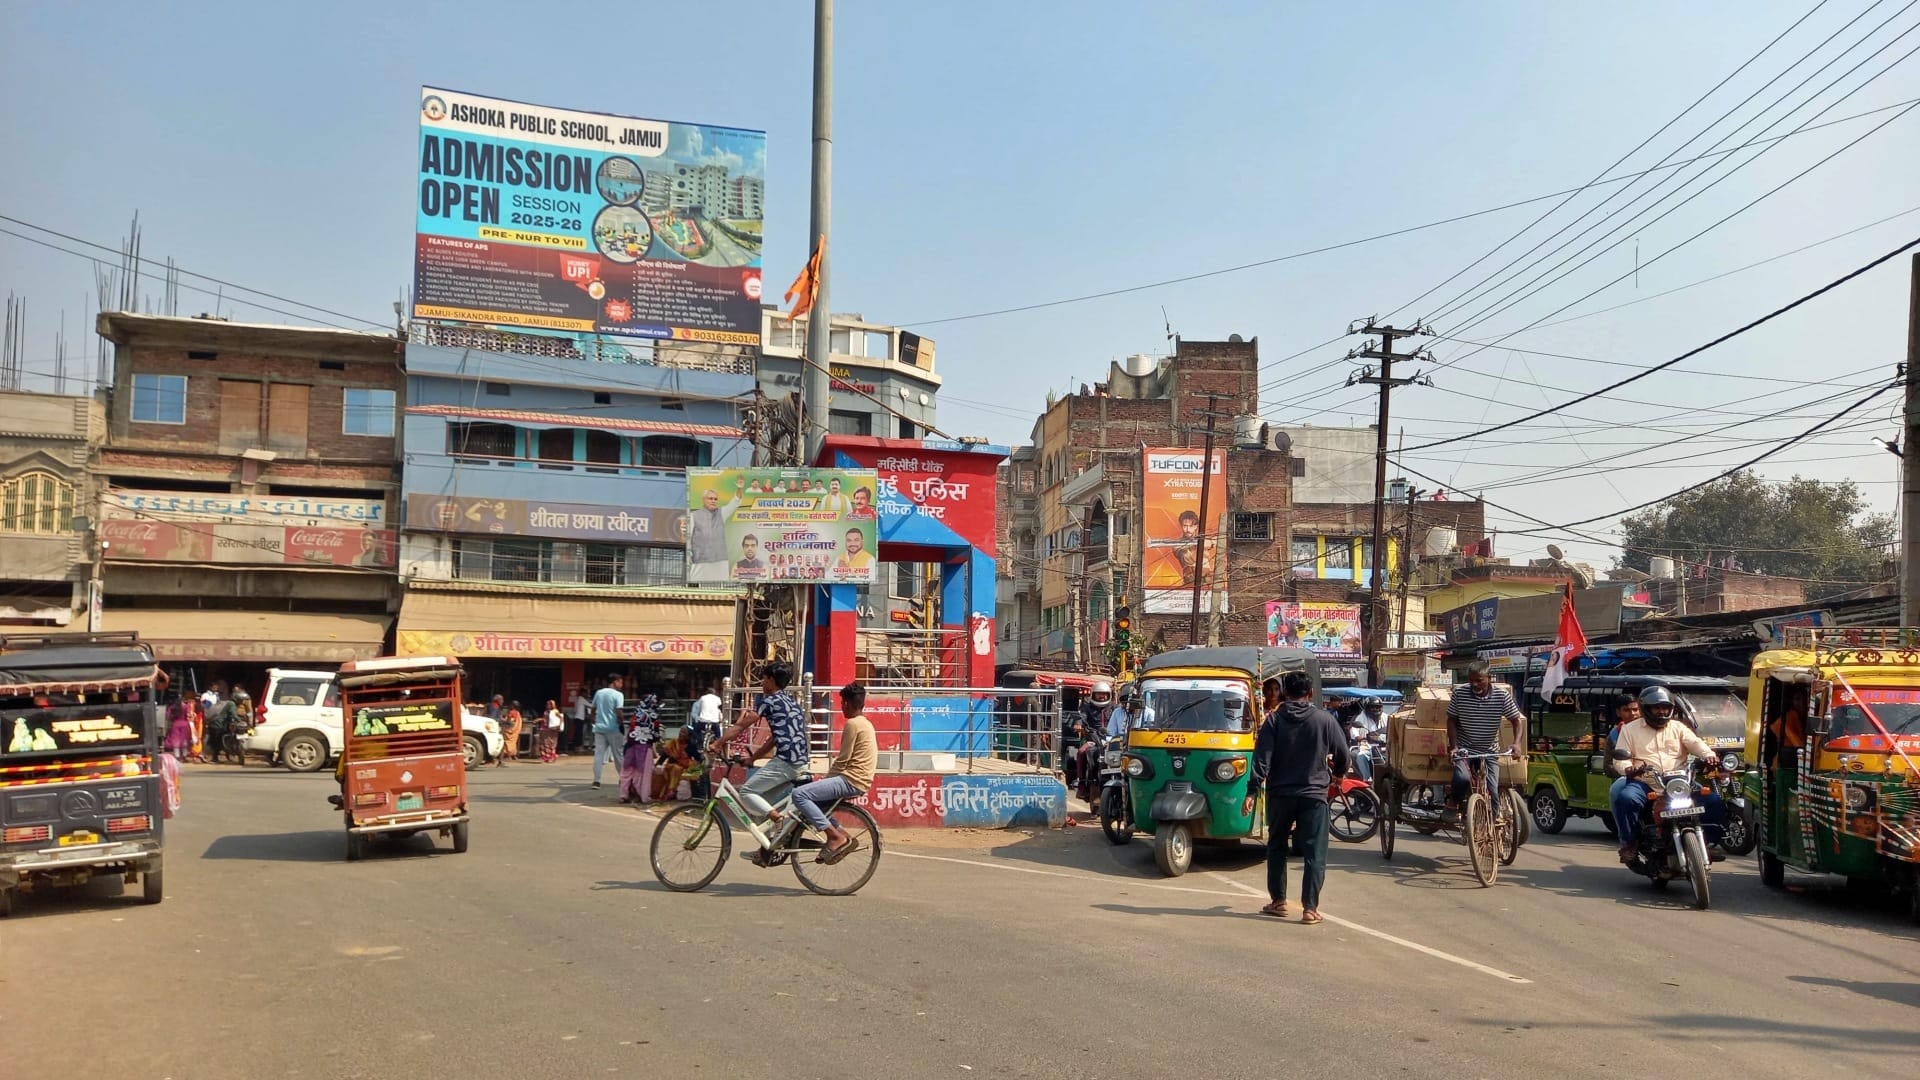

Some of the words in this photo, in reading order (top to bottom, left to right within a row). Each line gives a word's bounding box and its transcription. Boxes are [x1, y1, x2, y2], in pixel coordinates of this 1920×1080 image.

[450, 103, 505, 129] ASHOKA
[510, 112, 557, 136] PUBLIC
[560, 121, 615, 146] SCHOOL,
[619, 129, 662, 149] JAMUI
[421, 134, 592, 195] ADMISSION
[421, 178, 500, 225] OPEN
[512, 194, 581, 214] SESSION
[512, 212, 582, 231] 2025-26
[428, 238, 462, 248] FEATURES
[516, 232, 540, 243] NUR
[544, 236, 560, 246] TO
[565, 239, 584, 248] VIII
[567, 266, 590, 279] UP!
[524, 317, 548, 328] JAMUI
[910, 477, 970, 502] पुलिस
[530, 507, 568, 529] शीतल
[572, 511, 605, 530] छाया
[607, 512, 649, 536] स्वीट्स
[780, 530, 818, 541] हार्दिक
[475, 634, 532, 654] शीतल
[540, 637, 584, 654] छाया
[590, 634, 647, 657] स्वीट्स
[669, 636, 706, 654] केक
[873, 779, 928, 818] जमुई
[930, 781, 991, 817] पुलिस
